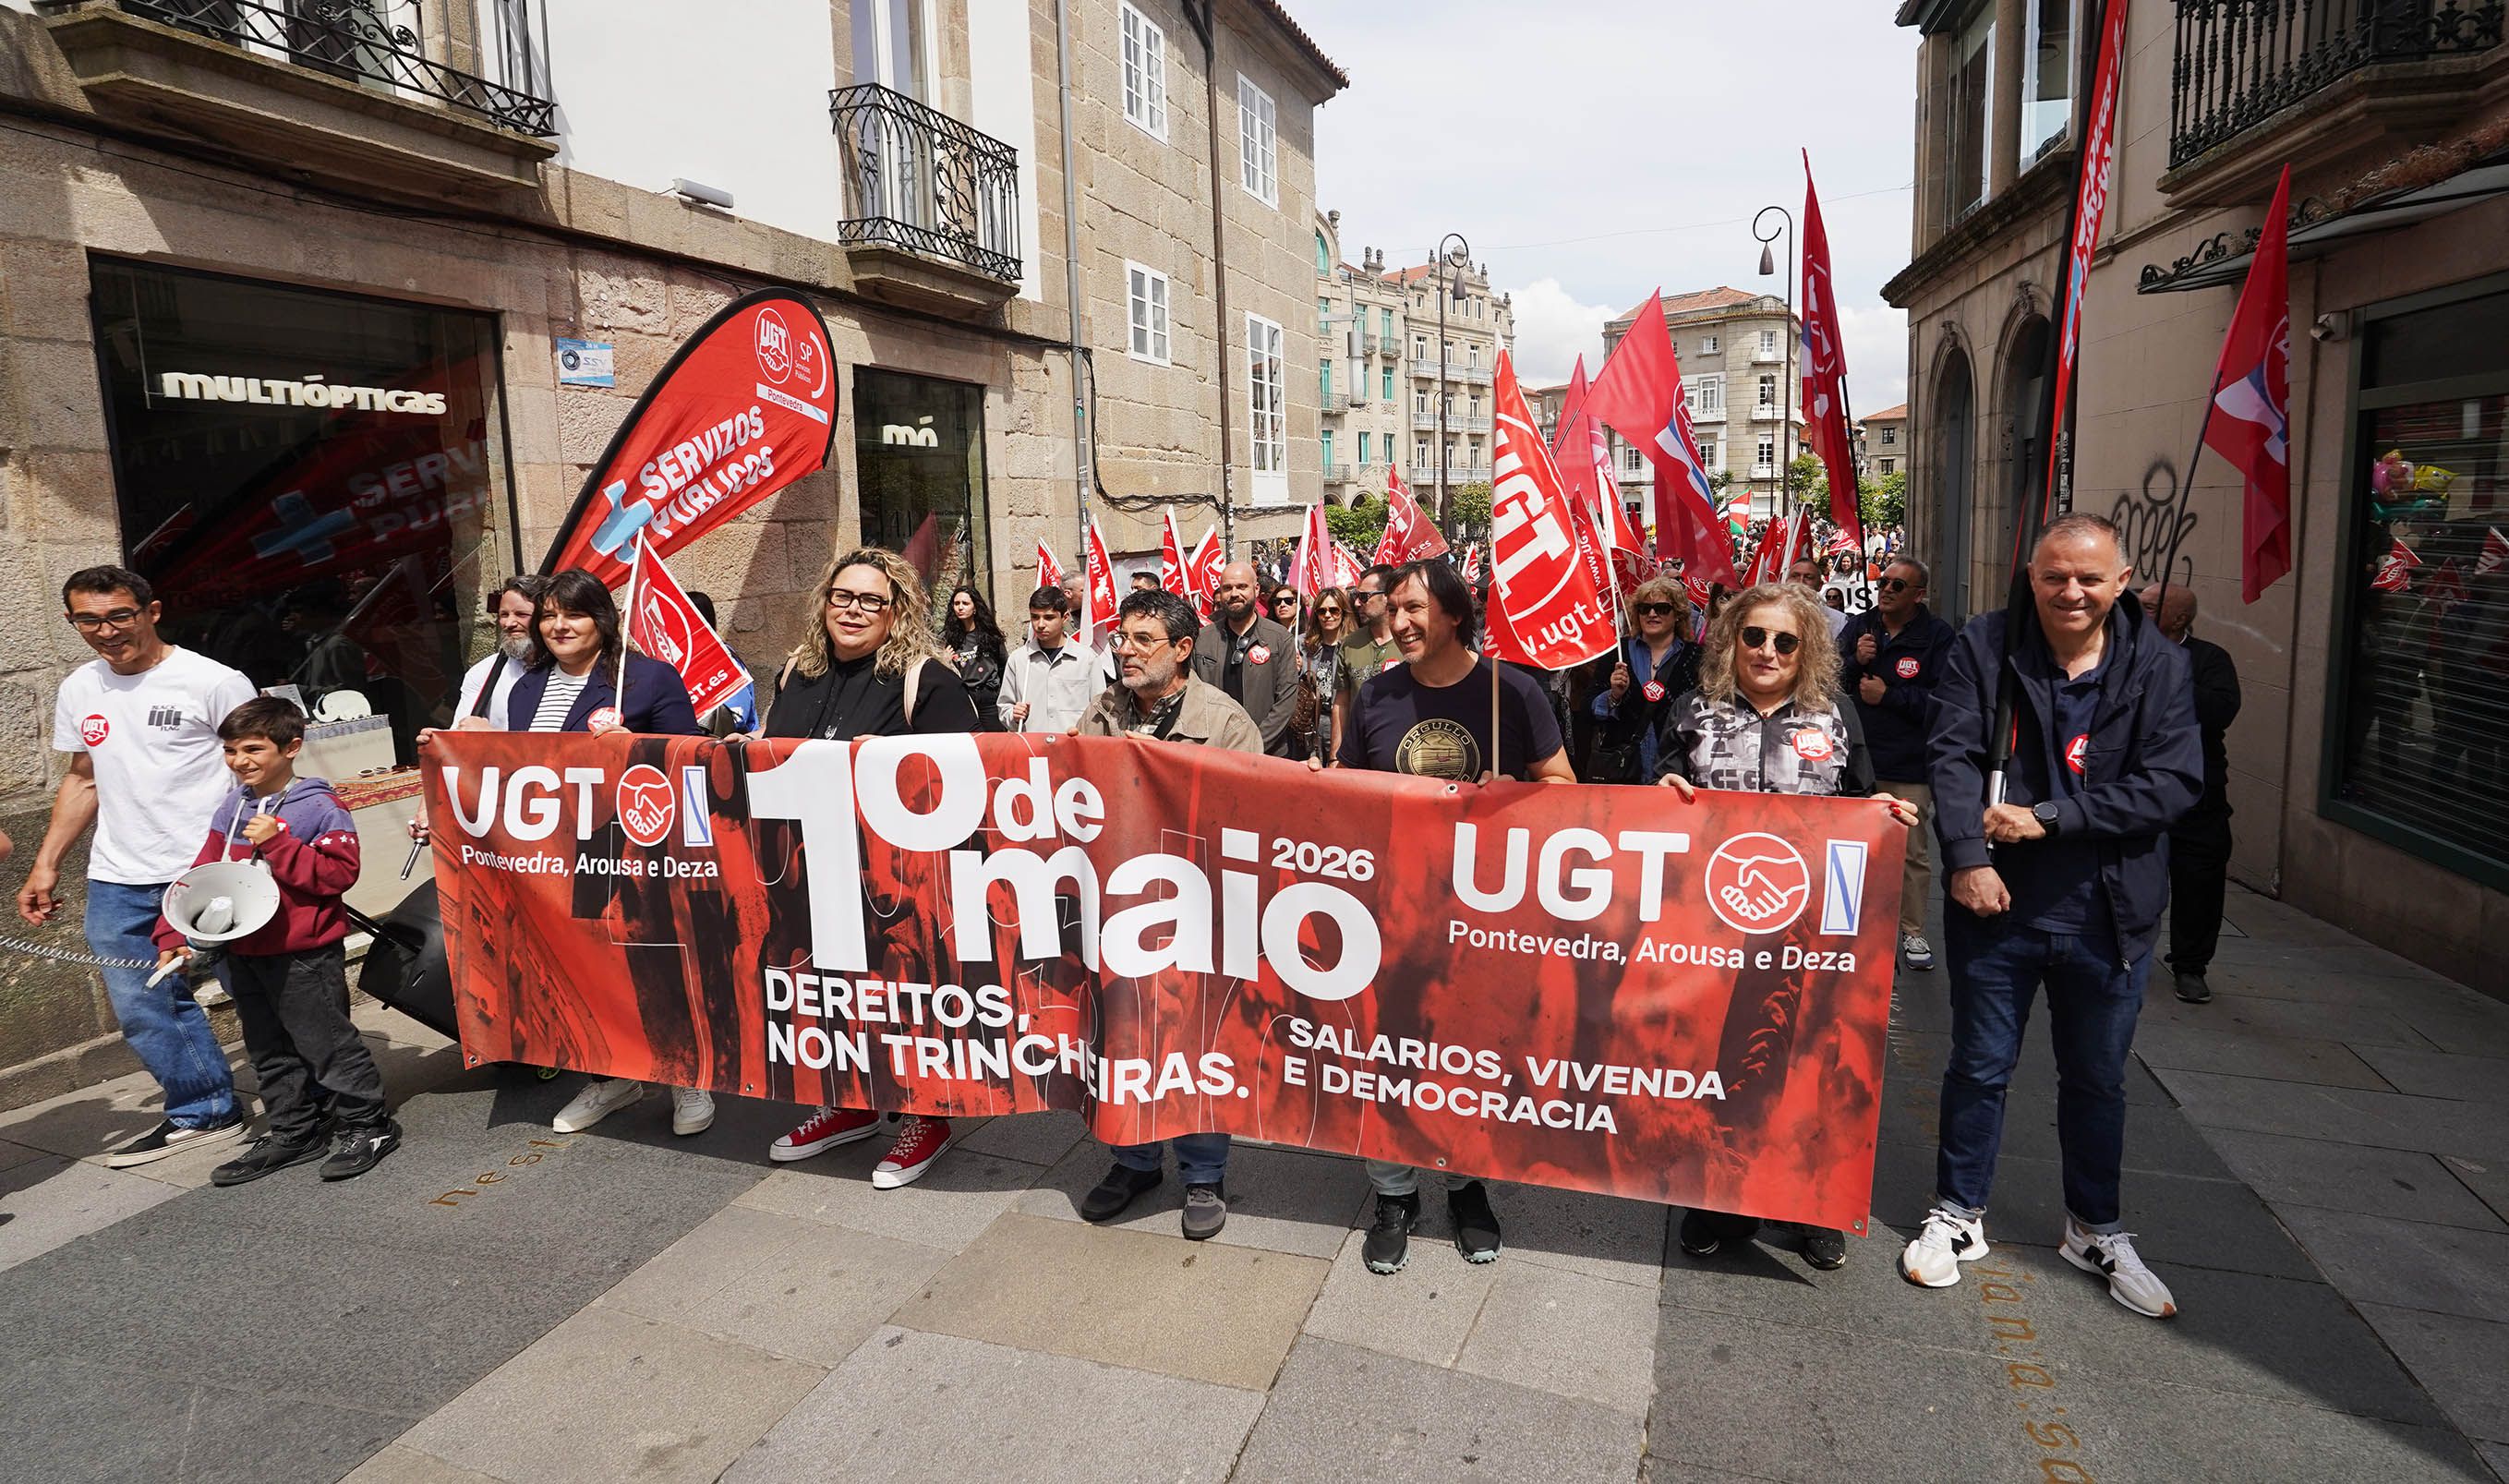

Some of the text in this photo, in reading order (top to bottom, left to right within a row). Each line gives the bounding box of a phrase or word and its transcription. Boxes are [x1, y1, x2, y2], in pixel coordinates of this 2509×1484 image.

[759, 318, 787, 356] UGT
[767, 389, 803, 411] Pontevedra
[639, 405, 764, 500] SERVIZOS
[650, 445, 775, 539] PÚBLICOS
[1898, 659, 1918, 670] UGT
[82, 718, 108, 732] UGT
[1404, 722, 1470, 750] ORGULLO
[441, 765, 605, 841] UGT
[993, 756, 1105, 843] de
[461, 844, 718, 877] Pontevedra, Arousa e Deza
[1271, 837, 1375, 882] 2026
[1453, 822, 1690, 922] UGT
[949, 827, 1382, 1001] maio
[1448, 920, 1856, 972] Pontevedra, Arousa e Deza
[765, 966, 1030, 1033] DEREITOS,
[767, 1021, 1249, 1106] NON TRINCHEIRAS.
[1284, 1056, 1619, 1134] E DEMOCRACIA
[1288, 1018, 1727, 1101] SALARIOS, VIVENDA
